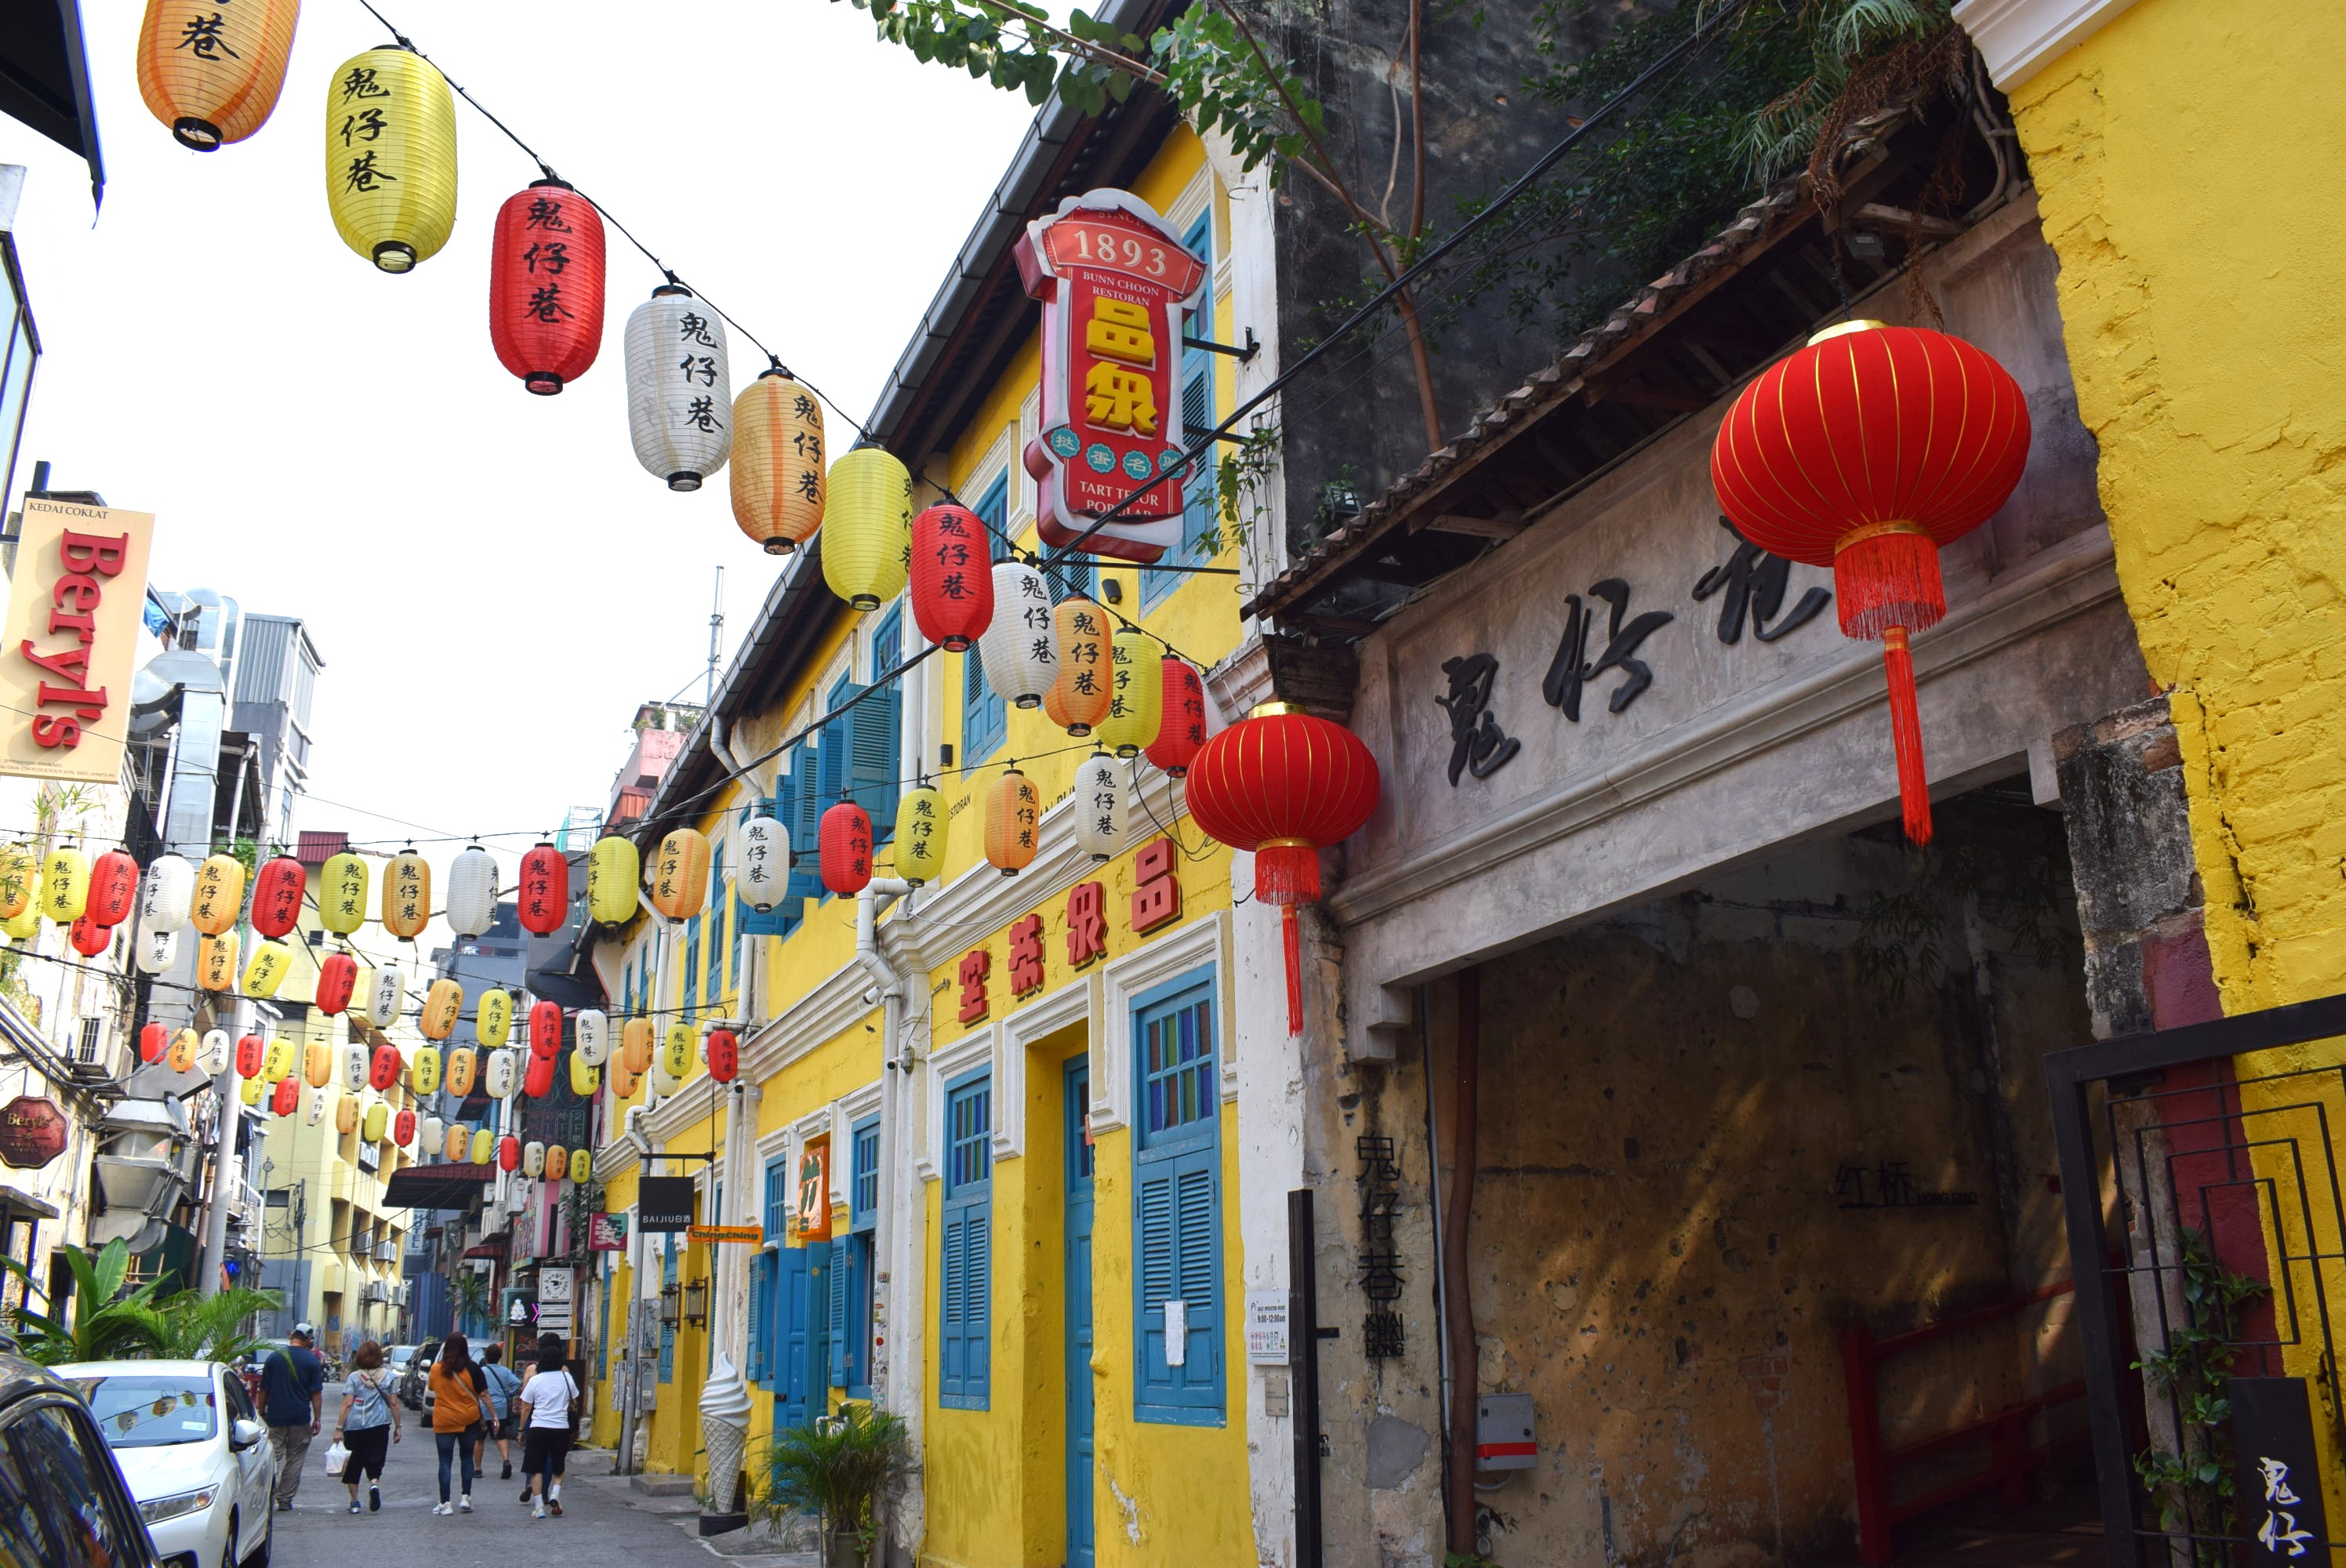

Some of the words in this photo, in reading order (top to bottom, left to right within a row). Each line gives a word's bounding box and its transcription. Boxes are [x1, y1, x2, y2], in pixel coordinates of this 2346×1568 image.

[174, 0, 240, 60] 巷
[340, 67, 398, 194] 鬼仔巷
[524, 198, 575, 324] 鬼仔巷
[1073, 230, 1167, 276] 1893
[1083, 271, 1115, 286] BUNN
[1117, 280, 1160, 296] CHOON
[1091, 285, 1150, 307] RESTORAN
[679, 311, 724, 434] 鬼仔巷
[794, 394, 823, 505] 鬼仔巷
[28, 503, 64, 515] KEDAI
[65, 506, 109, 520] COKLAT
[1080, 481, 1113, 497] TART
[1116, 488, 1159, 506] TEUR
[936, 513, 975, 601] 鬼仔巷
[20, 528, 129, 748] Beryl's
[1021, 574, 1057, 664] 鬼仔巷
[1071, 611, 1102, 696] 鬼仔巷
[1183, 672, 1204, 745] 鬼仔巷
[1017, 785, 1036, 848] 鬼仔巷
[1094, 769, 1118, 835] 鬼仔巷
[850, 815, 869, 876] 鬼仔巷
[910, 799, 935, 859] 鬼仔巷
[659, 839, 681, 898] 鬼仔巷
[747, 826, 770, 883] 鬼仔巷
[53, 861, 72, 909] 鬼仔巷
[108, 864, 129, 913] 鬼仔巷
[143, 865, 162, 916] 鬼仔巷
[198, 866, 220, 919] 鬼仔巷
[273, 870, 298, 924] 鬼仔巷
[339, 863, 362, 915] 鬼仔巷
[399, 864, 421, 920] 鬼仔巷
[528, 858, 550, 916] 鬼仔巷
[208, 939, 228, 983] 鬼仔巷
[249, 953, 274, 992] 鬼仔巷
[377, 975, 396, 1016] 鬼仔巷
[440, 991, 460, 1032] 鬼仔巷
[487, 998, 504, 1036] 鬼仔巷
[211, 1036, 223, 1067] 鬼仔巷
[543, 1010, 557, 1048] 鬼仔巷
[580, 1018, 597, 1058] 鬼仔巷
[672, 1031, 685, 1066] 鬼仔巷
[265, 1046, 282, 1076] 鬼仔巷
[350, 1052, 363, 1084] 鬼仔巷
[376, 1053, 391, 1083] 鬼仔巷
[420, 1056, 433, 1086] 鬼仔巷
[453, 1054, 467, 1087] 鬼仔巷
[499, 1057, 511, 1091] 鬼仔巷
[722, 1039, 734, 1073] 鬼仔巷
[7, 1112, 53, 1130] Beryl's
[412, 1214, 423, 1249] HOTEL
[642, 1215, 674, 1224] BAIJIU
[692, 1230, 758, 1241] ChingChing
[1355, 1131, 1406, 1301] 鬼仔巷
[1364, 1327, 1404, 1342] CHAI
[1365, 1312, 1404, 1328] KWAI
[1365, 1341, 1405, 1357] HONG
[2257, 1457, 2315, 1568] 鬼仔
